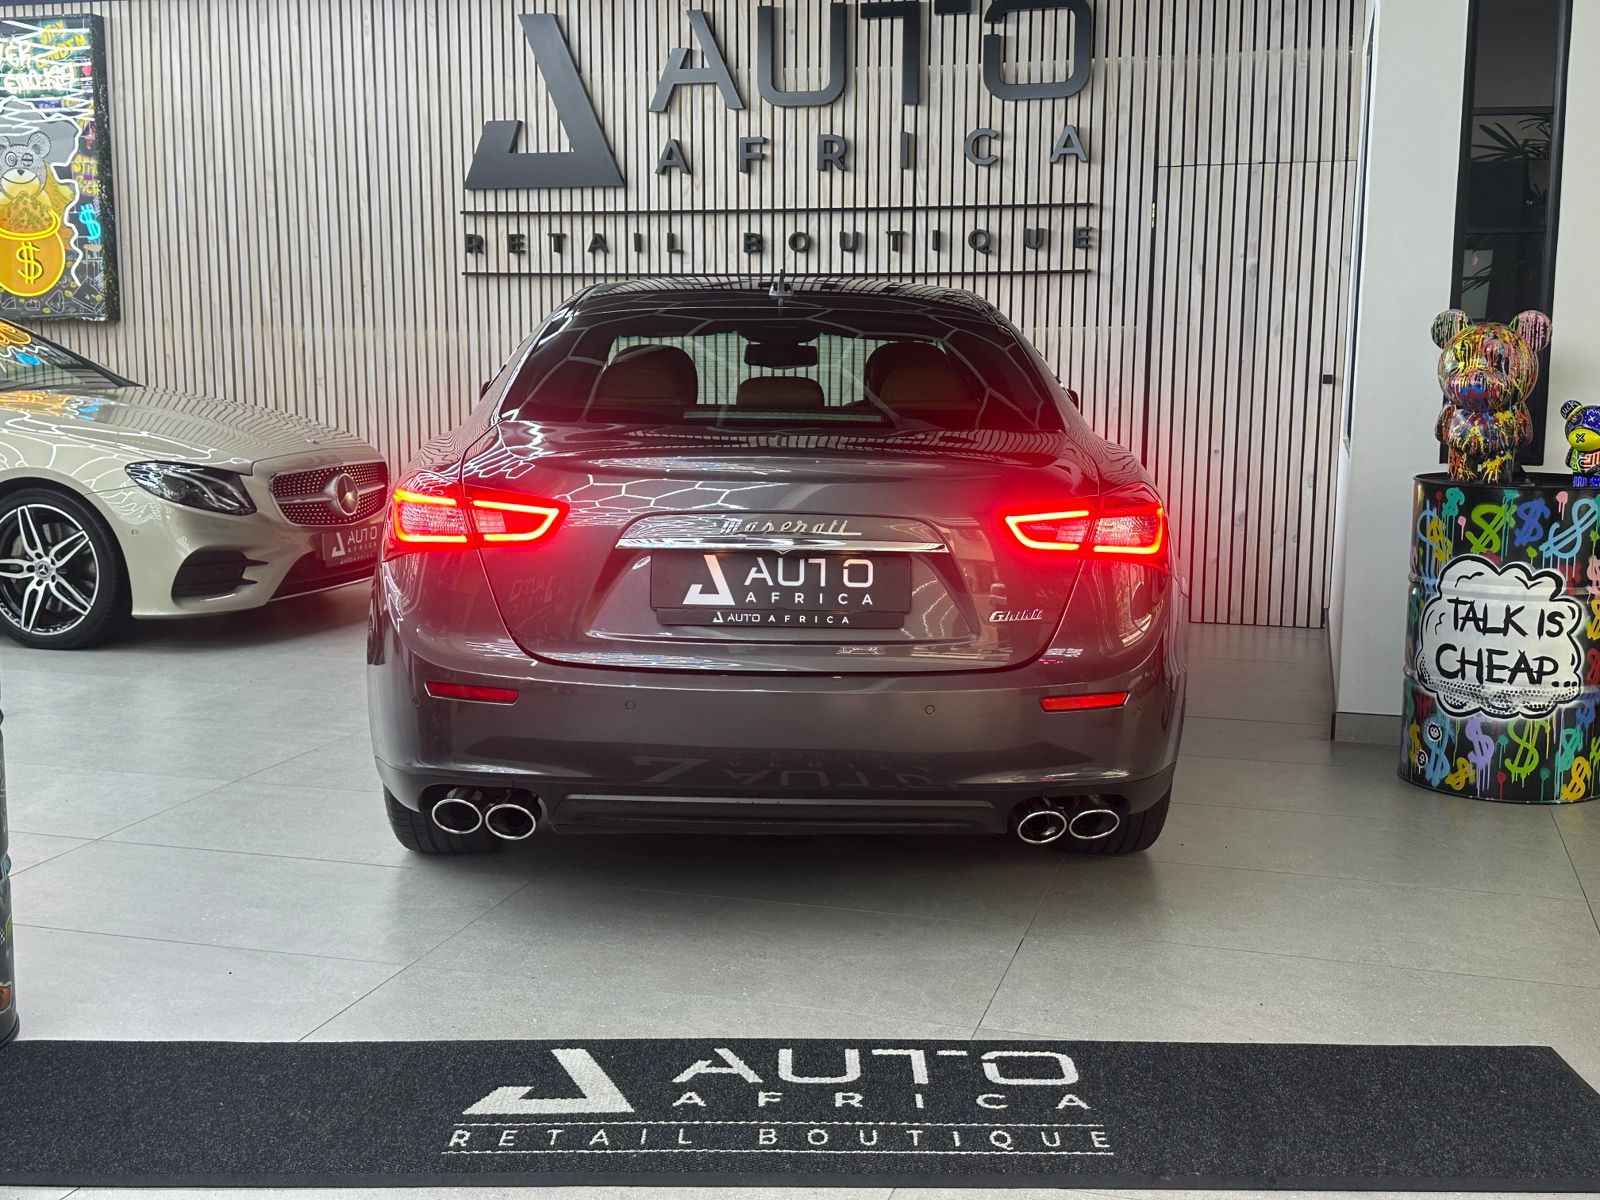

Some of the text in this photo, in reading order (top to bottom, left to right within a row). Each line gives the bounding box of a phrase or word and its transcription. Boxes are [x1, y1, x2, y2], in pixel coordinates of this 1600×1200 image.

[649, 0, 1094, 112] AUTO
[655, 124, 1089, 175] AFRICA
[464, 226, 1095, 255] RETAIL BOUTIQUE
[347, 526, 377, 545] AUTO
[719, 517, 863, 536] Maserati
[744, 557, 874, 588] AUTO
[745, 591, 874, 606] AFRICA
[727, 612, 850, 625] AUTO AFRICA
[1446, 596, 1566, 640] TALK IS
[671, 1047, 1080, 1086] AUTO
[671, 1090, 1092, 1111] AFRICA
[448, 1128, 1112, 1149] RETAIL BOUTIQUE
